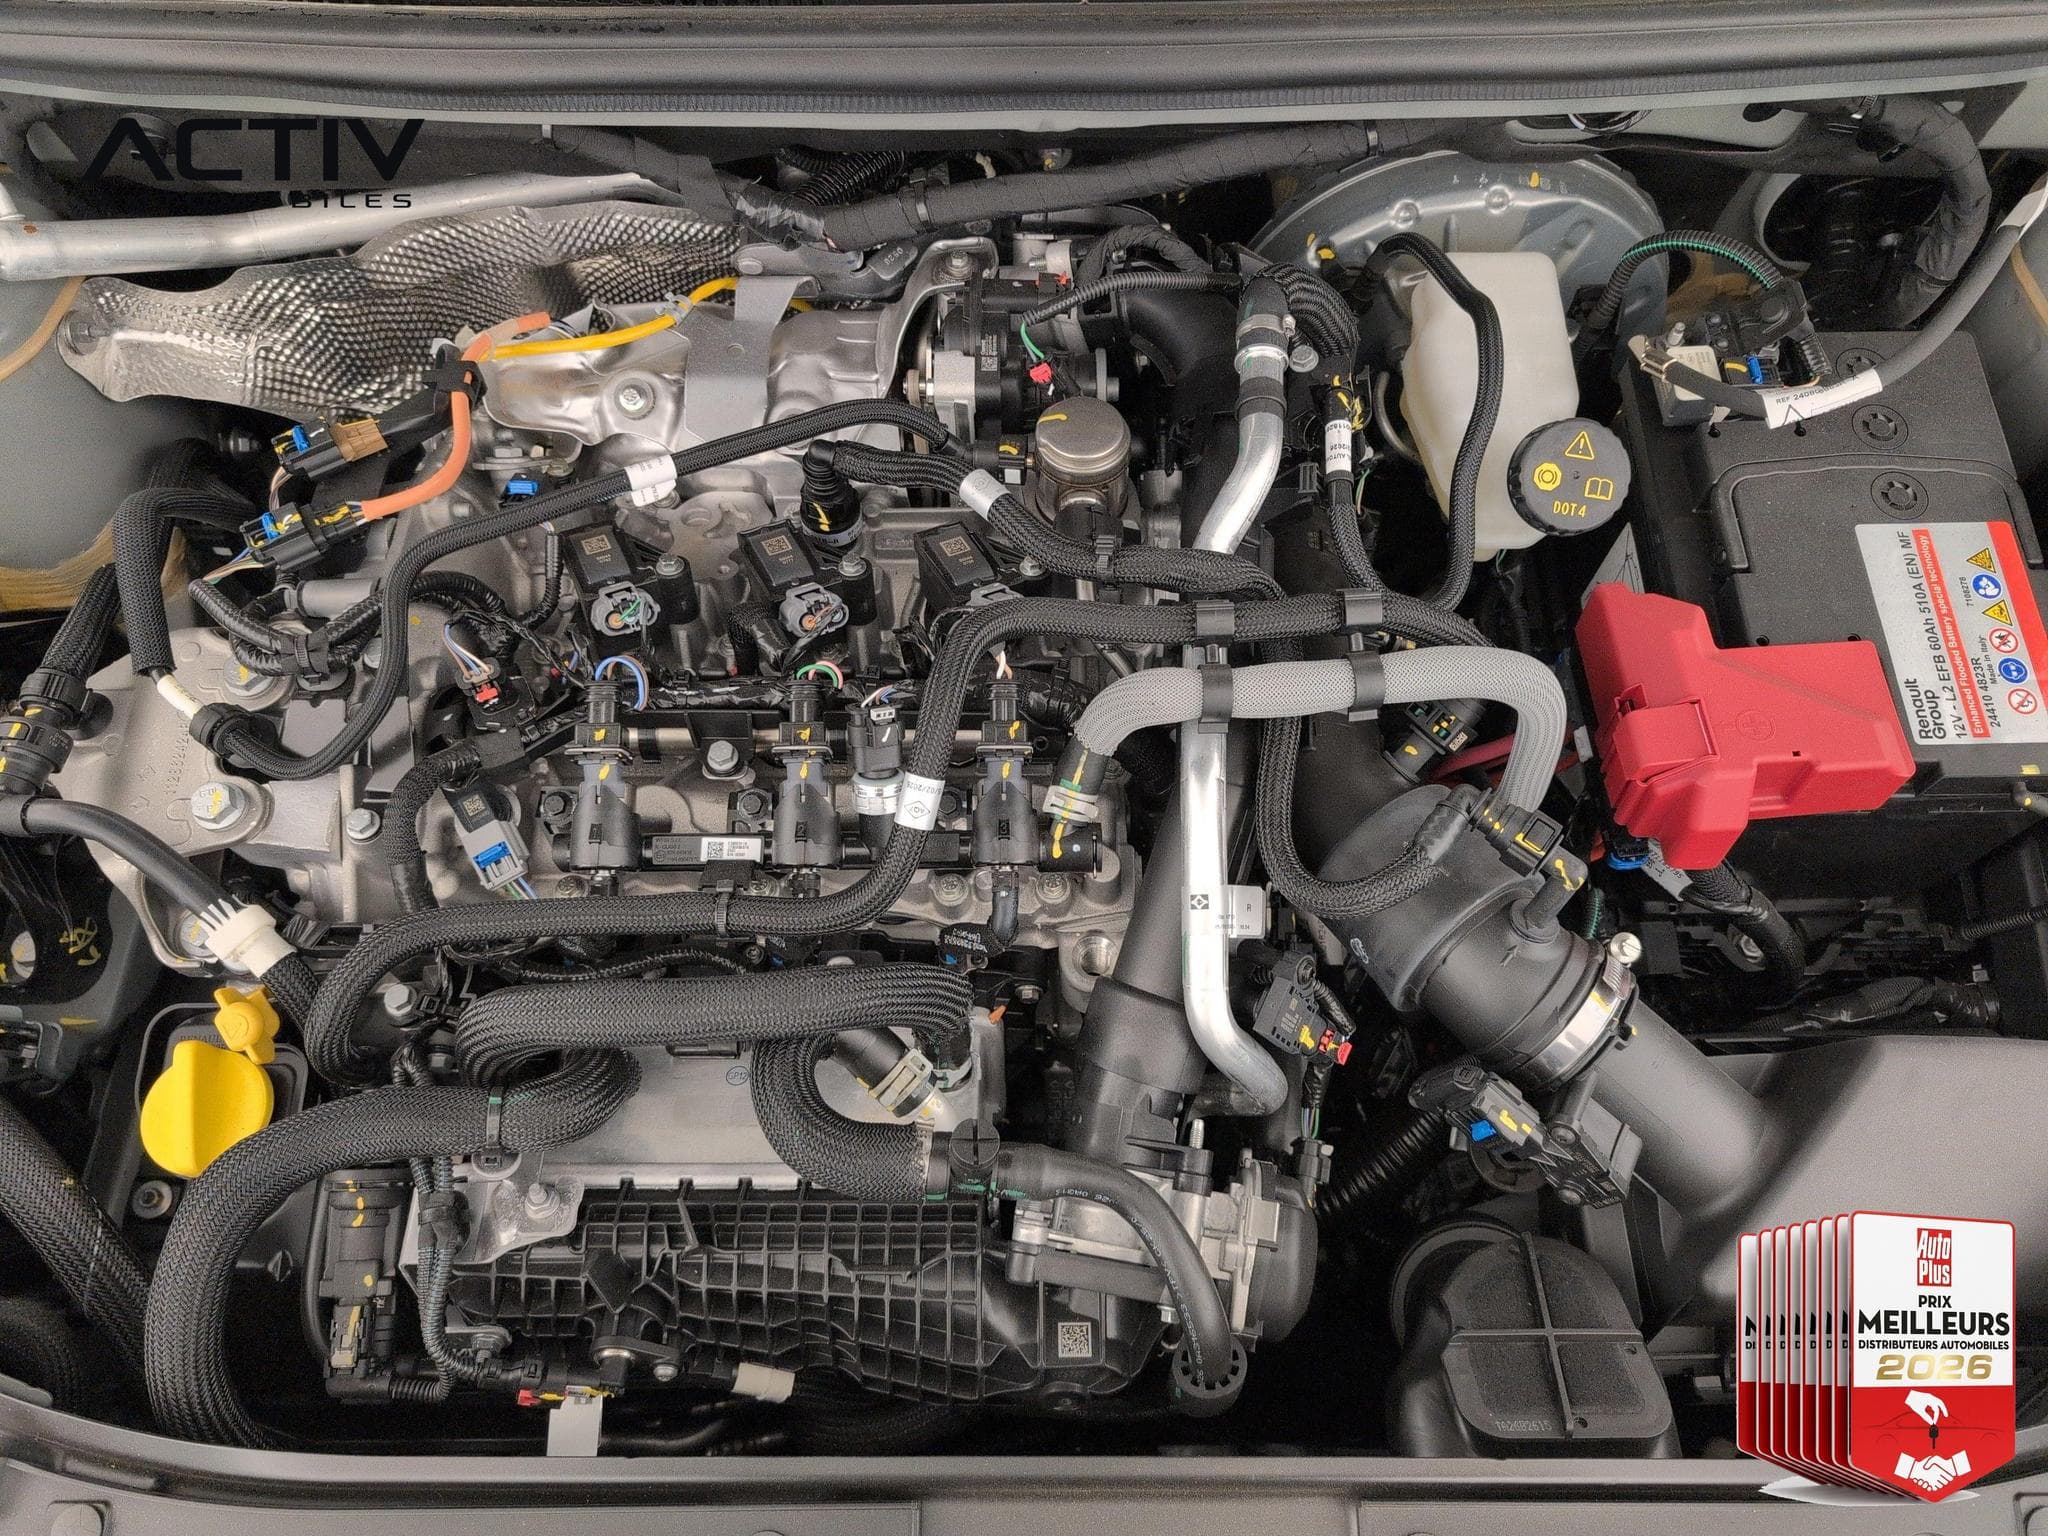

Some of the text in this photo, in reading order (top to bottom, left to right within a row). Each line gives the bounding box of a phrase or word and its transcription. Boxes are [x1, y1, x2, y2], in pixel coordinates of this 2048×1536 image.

[1896, 530, 1912, 549] MF
[1902, 553, 1923, 579] (EN)
[1912, 582, 1931, 614] 510A
[1919, 535, 1984, 735] Enhanced Flooded Battery special technology
[1923, 617, 1941, 651] 60Ah
[1932, 654, 1951, 681] EFB
[1978, 637, 1998, 685] Made in Italy
[1904, 678, 1934, 739] Renault
[1942, 685, 1957, 701] L2
[1970, 657, 2001, 728] 24410 4823R
[1923, 689, 1947, 740] Group
[1949, 714, 1968, 739] 12V
